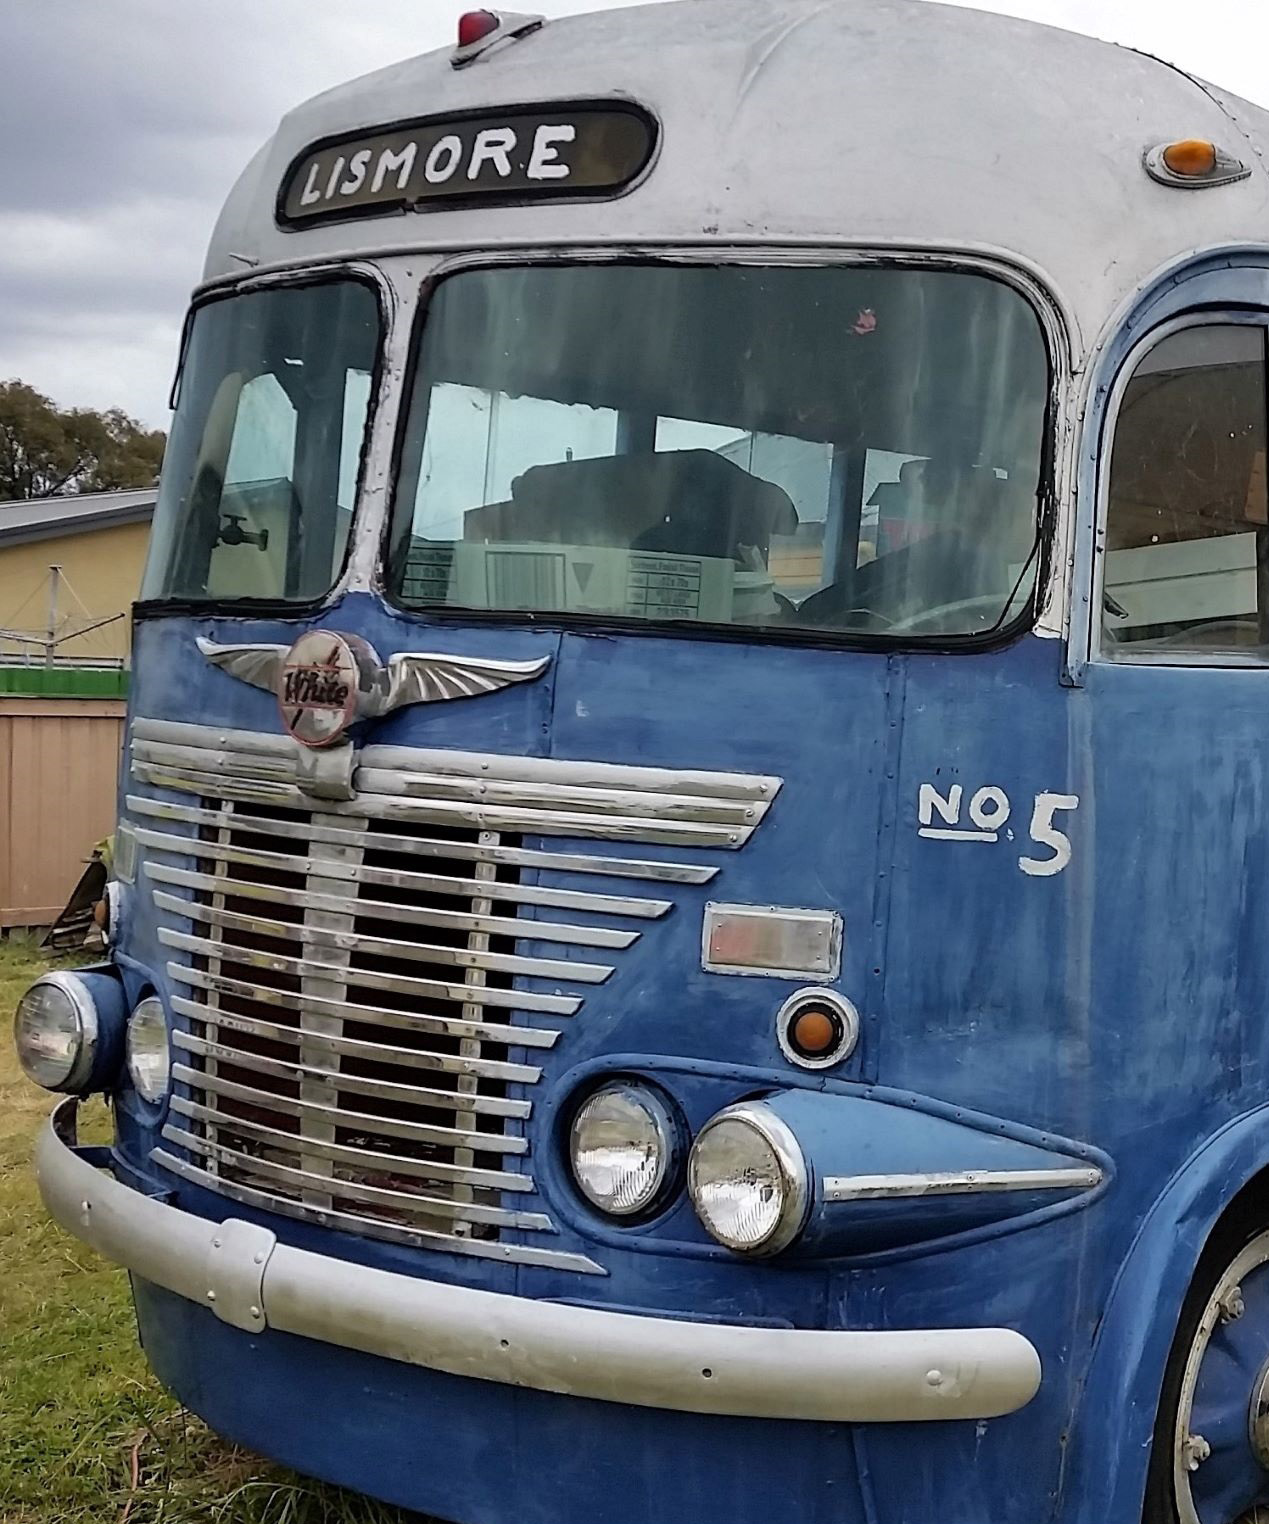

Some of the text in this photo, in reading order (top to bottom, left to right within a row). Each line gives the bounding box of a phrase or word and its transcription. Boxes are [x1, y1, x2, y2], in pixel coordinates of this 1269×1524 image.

[300, 124, 577, 206] LISMORE
[283, 667, 349, 707] White
[1017, 788, 1080, 876] 5
